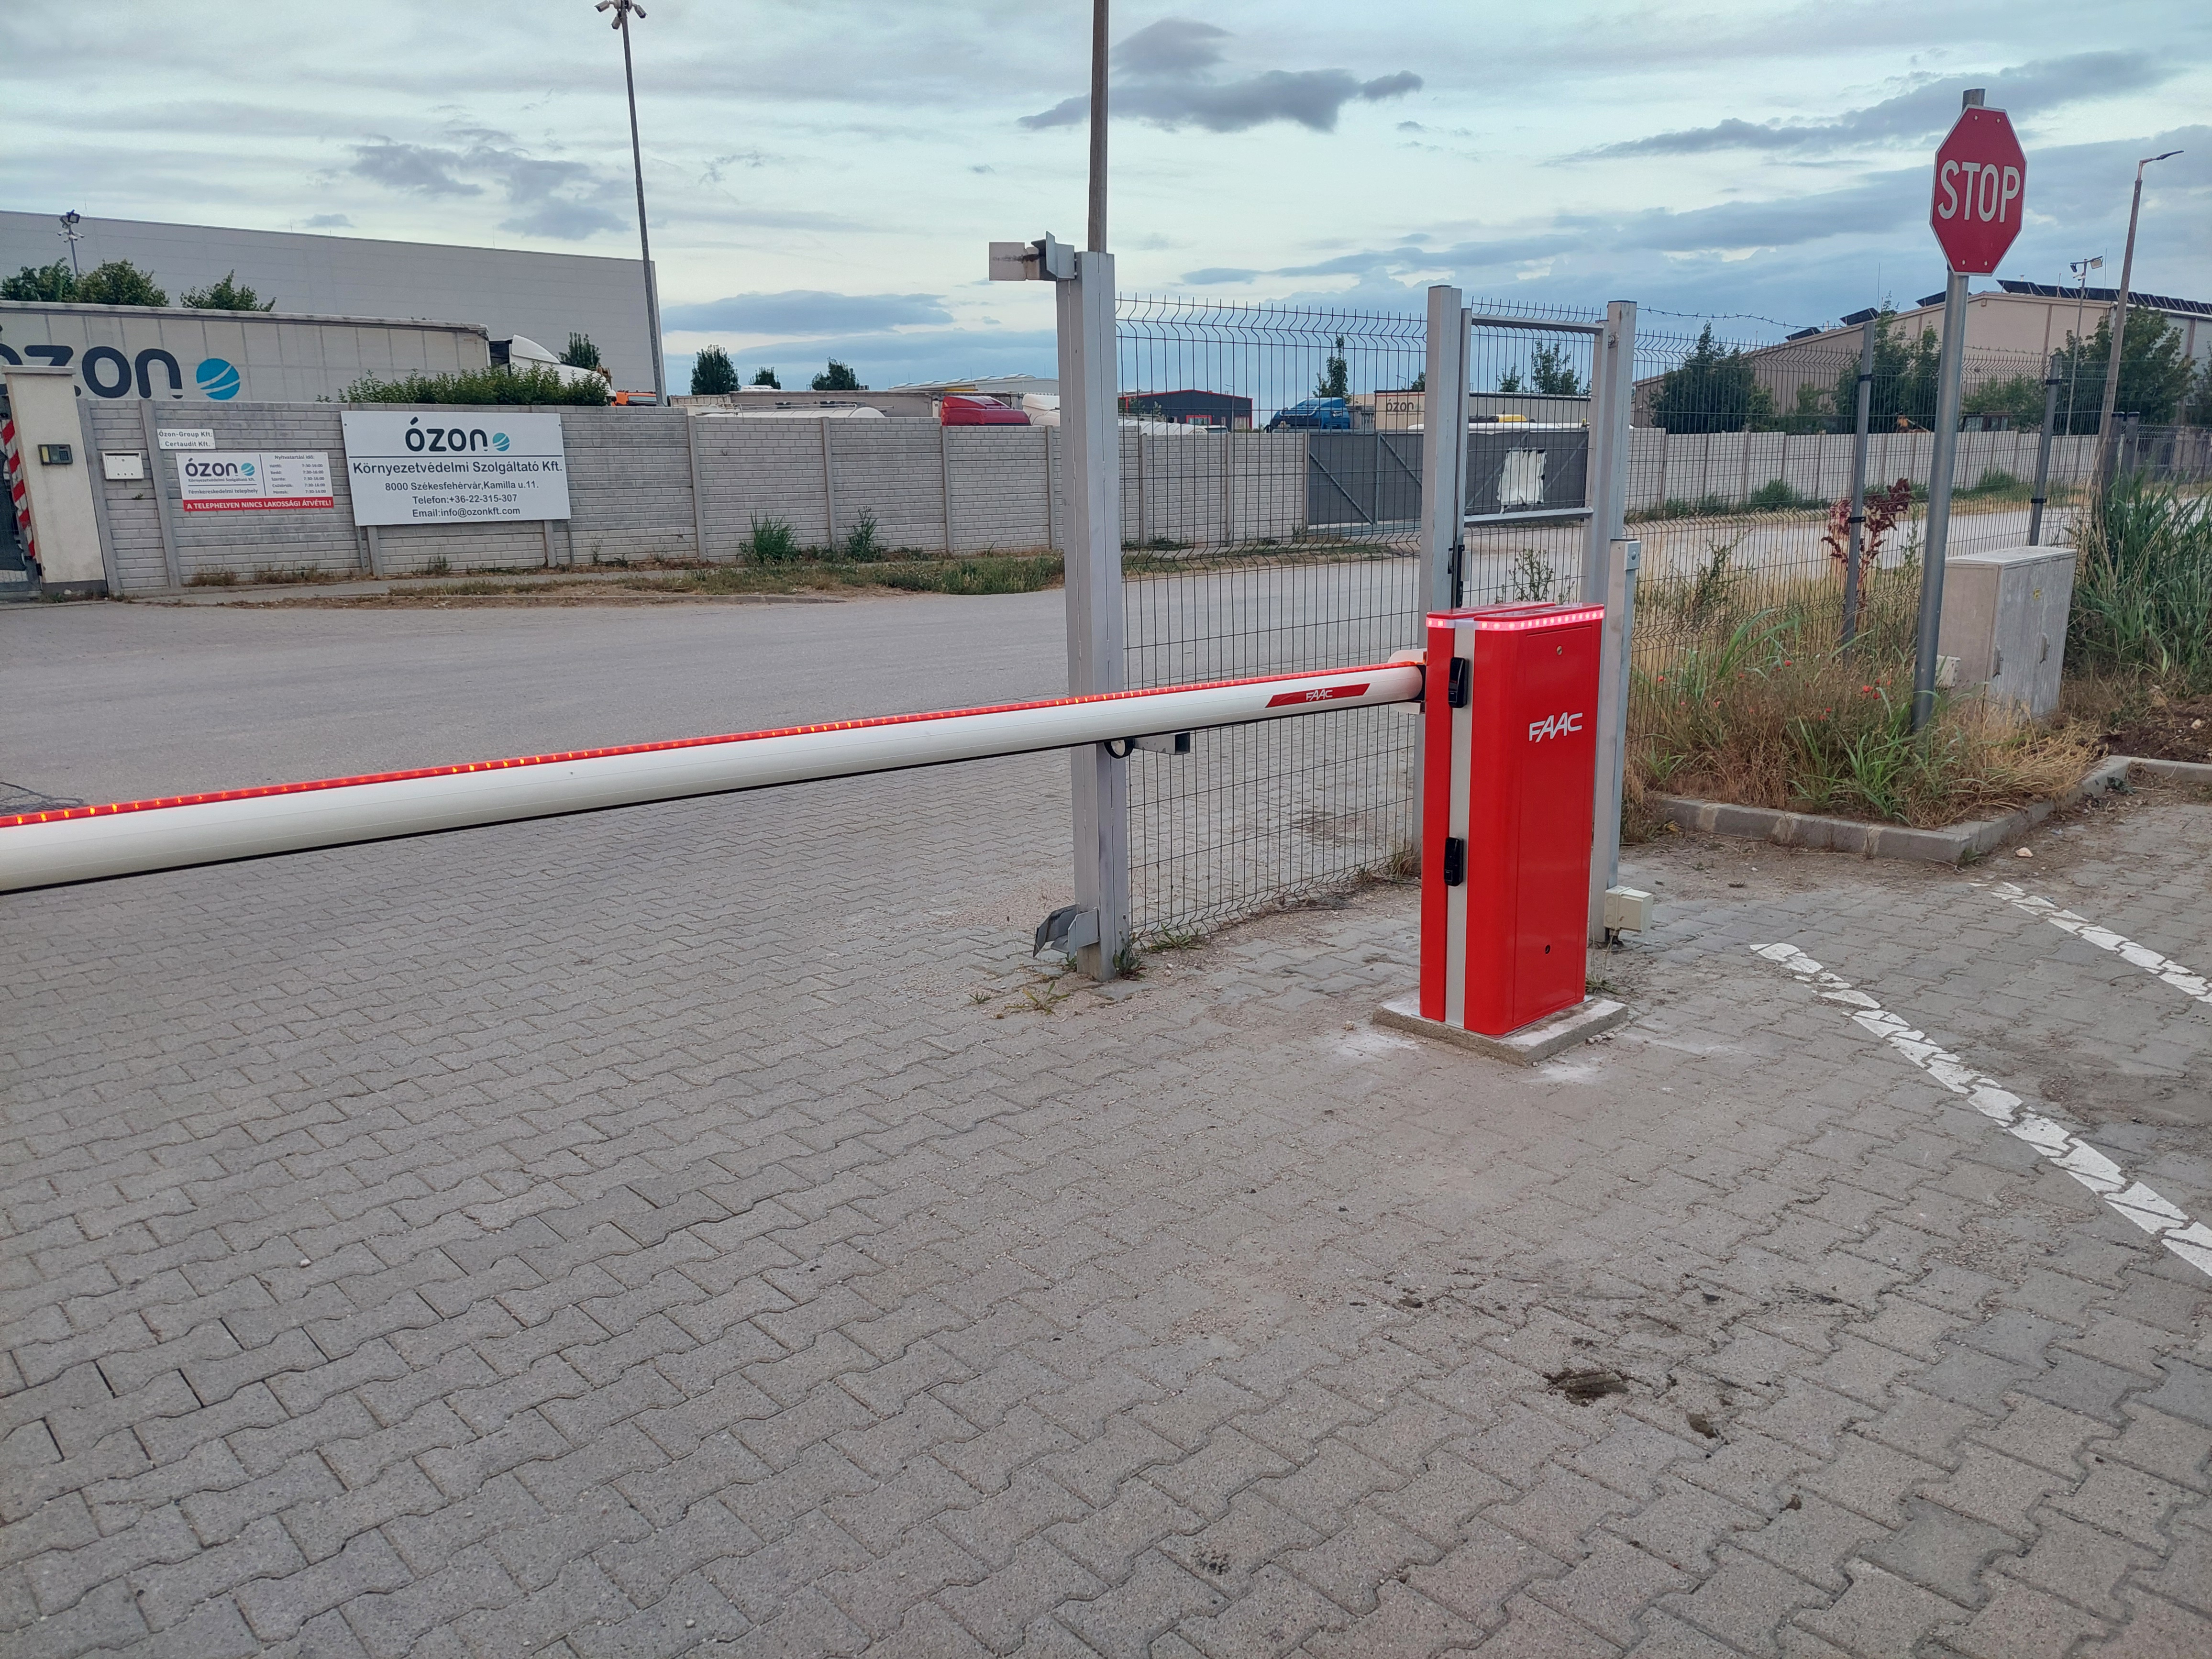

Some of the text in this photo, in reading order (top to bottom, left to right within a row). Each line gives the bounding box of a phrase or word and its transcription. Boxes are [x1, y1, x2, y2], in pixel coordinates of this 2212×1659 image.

[1937, 160, 2021, 223] STOP
[158, 430, 199, 438] Ózon-Group
[353, 461, 563, 476] Környezetvédelmi Szolgáltató Kft.
[385, 482, 408, 491] 8000
[518, 480, 539, 488] u.11.
[412, 494, 517, 504] Telefon:+36-22-315-307
[412, 507, 520, 518] Email:info@ozonkft.com
[1306, 689, 1333, 701] FAAC
[1529, 712, 1583, 743] FAAC
